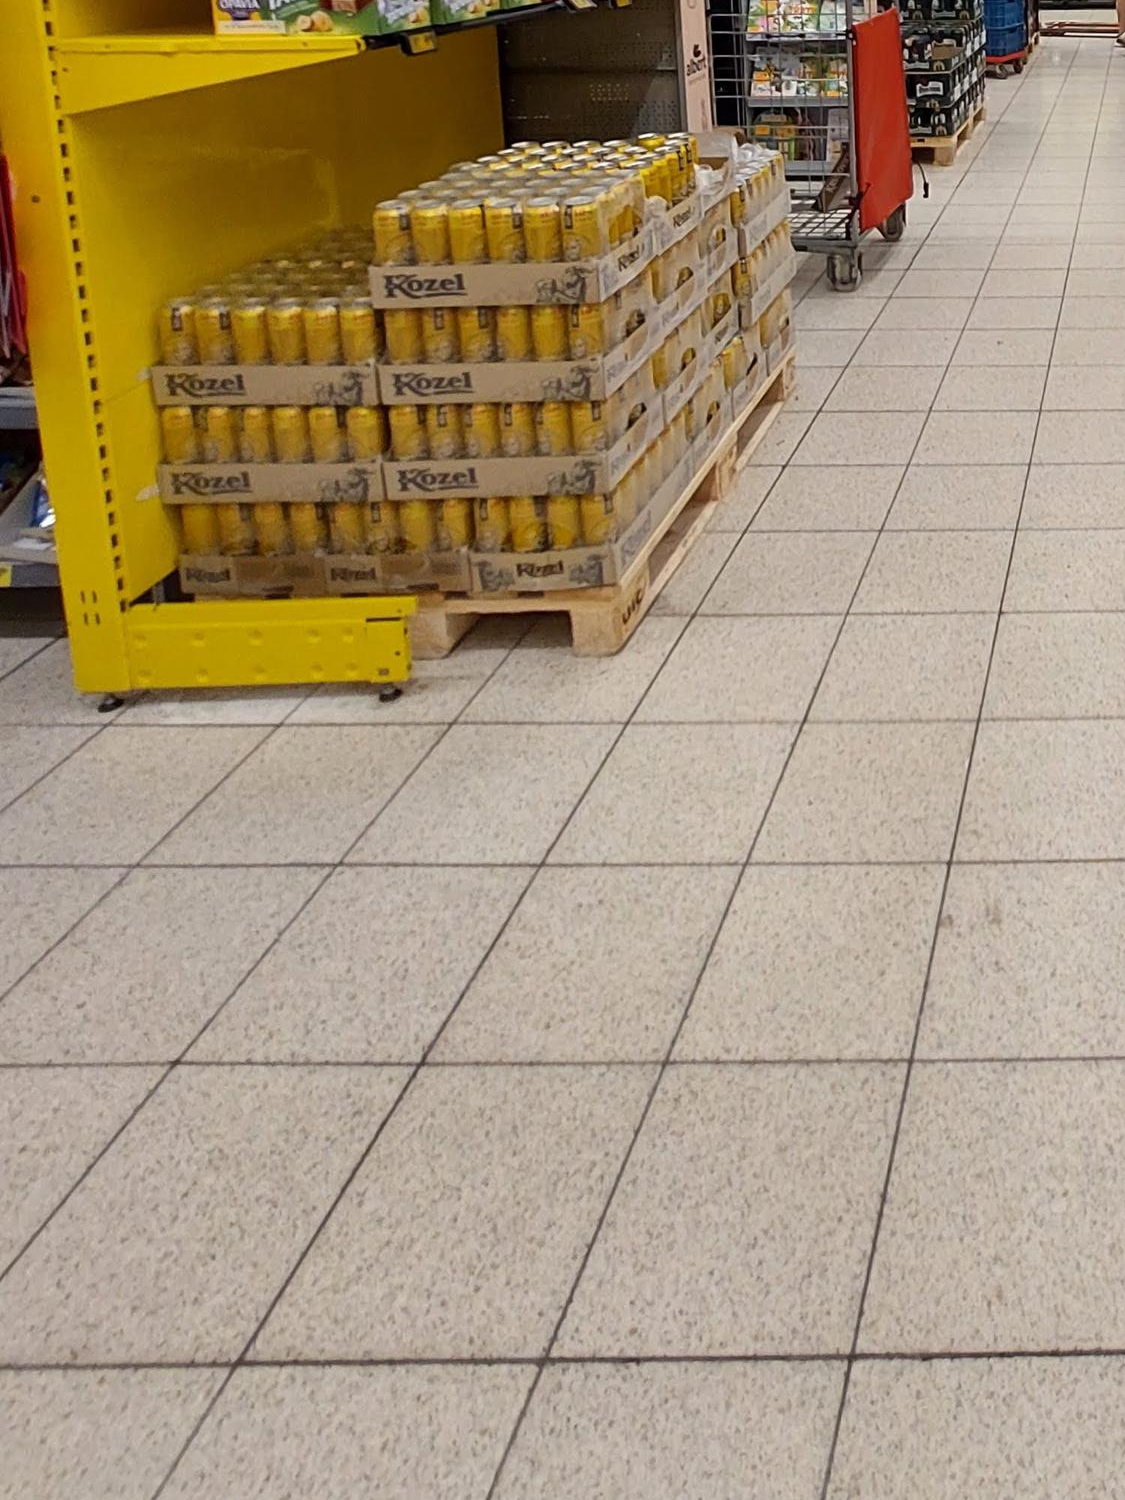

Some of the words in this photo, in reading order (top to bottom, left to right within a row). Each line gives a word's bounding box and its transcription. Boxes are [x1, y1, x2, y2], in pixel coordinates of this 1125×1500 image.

[383, 273, 467, 299] Kozel
[164, 373, 247, 397] Kozel
[392, 371, 475, 397] Kozel
[171, 470, 253, 495] Kozel
[397, 467, 479, 493] Kozel
[516, 560, 565, 578] Kozel
